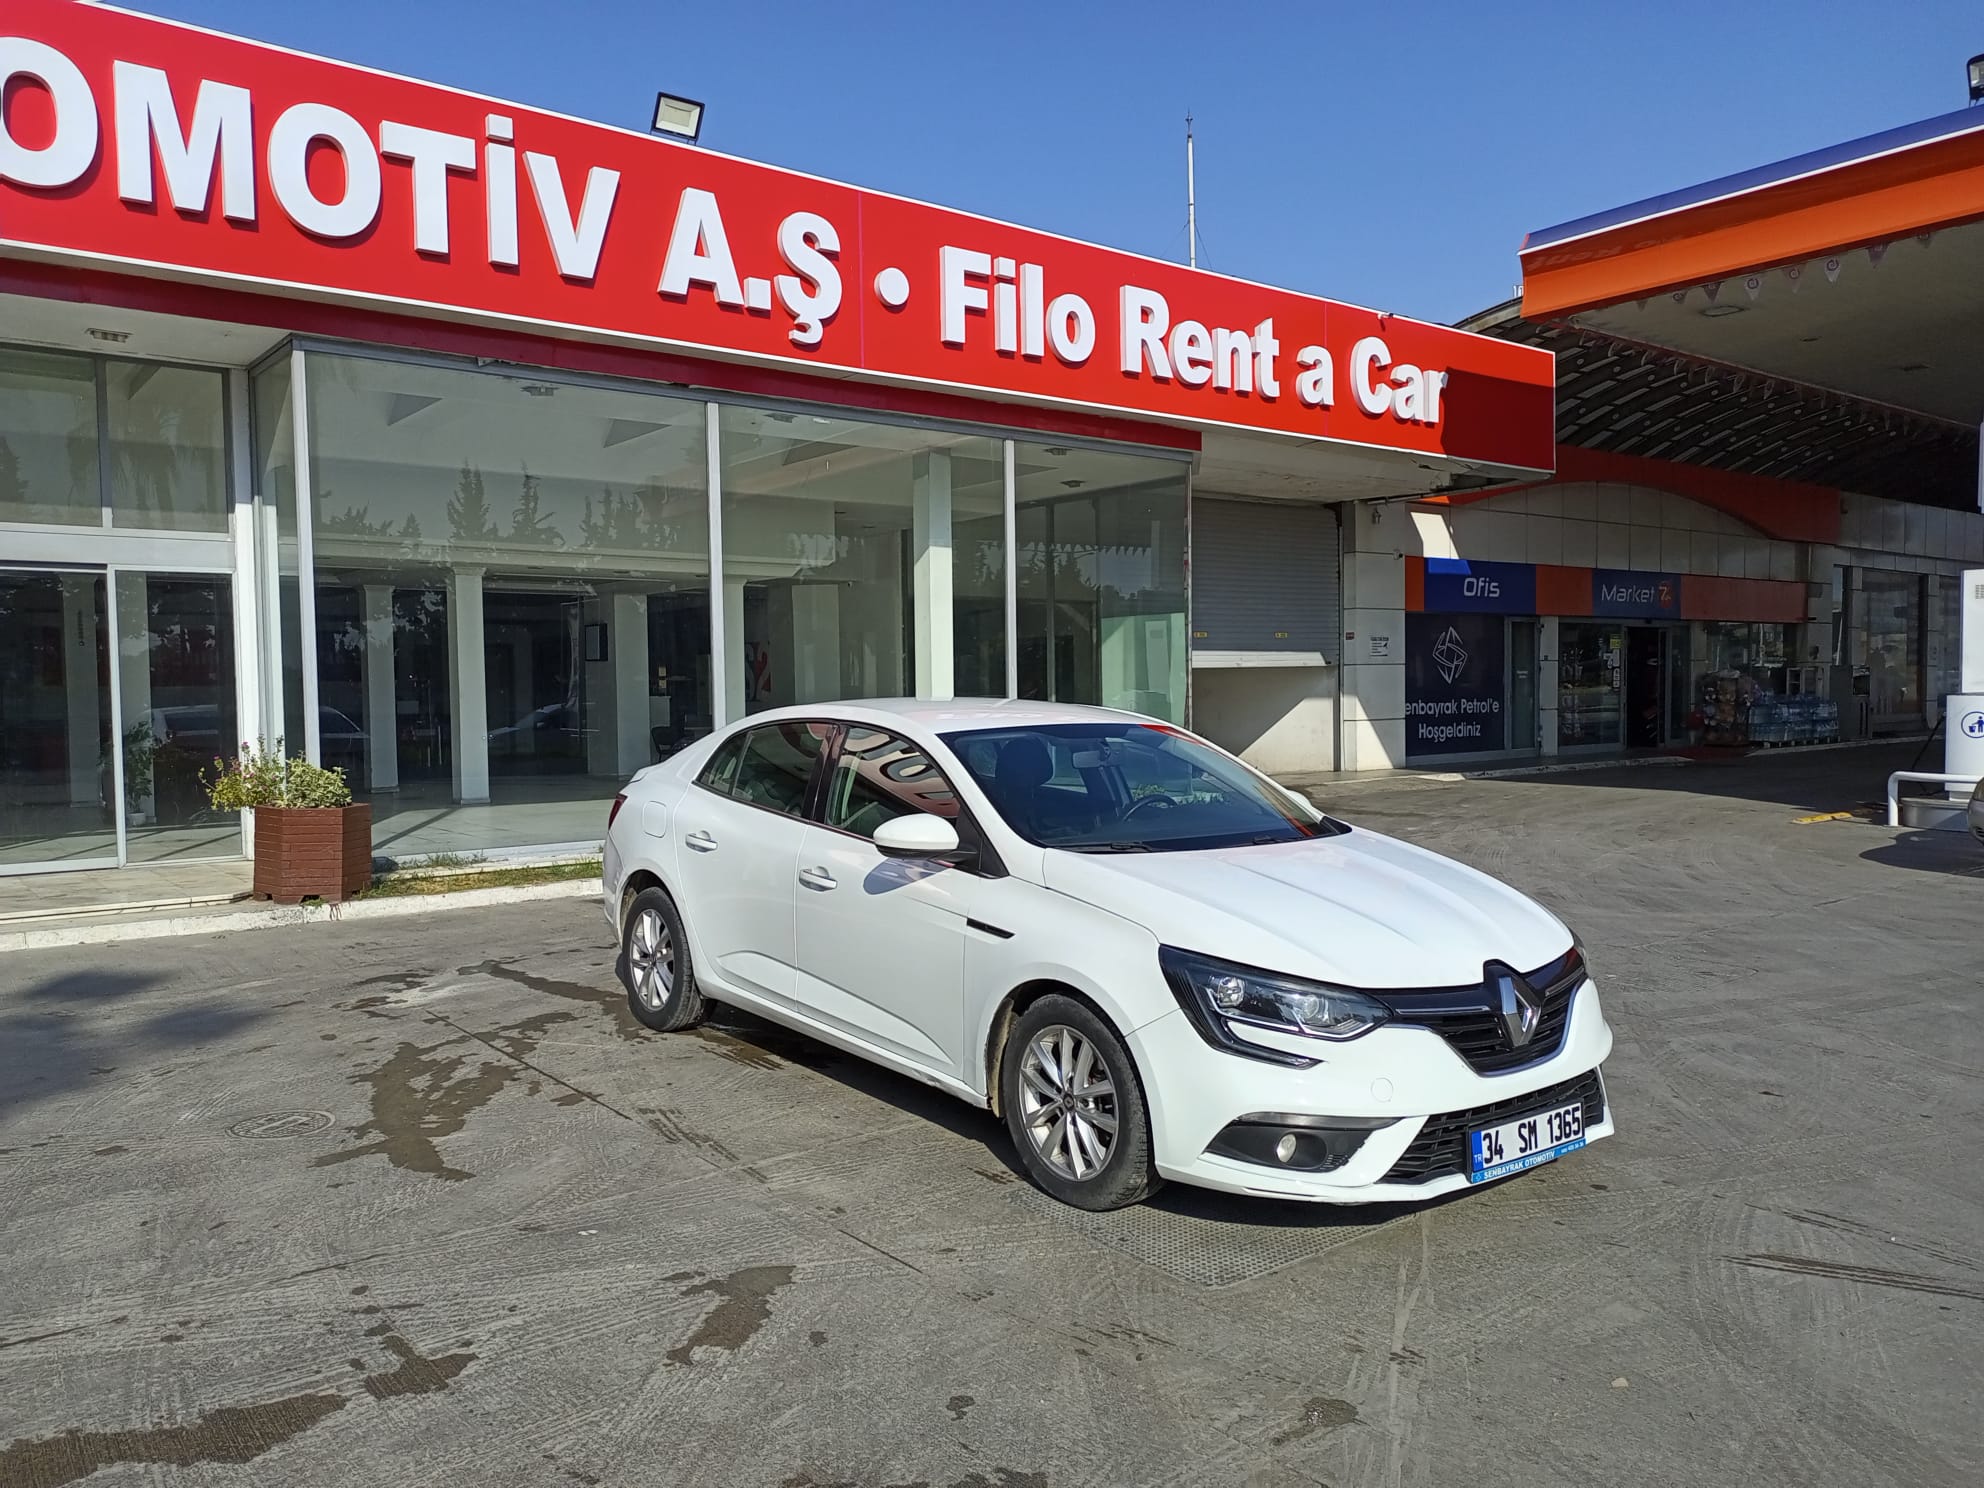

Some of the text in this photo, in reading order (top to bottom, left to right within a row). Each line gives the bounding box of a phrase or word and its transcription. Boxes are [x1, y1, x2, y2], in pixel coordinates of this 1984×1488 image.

[657, 186, 843, 345] A.Ş
[938, 245, 1096, 363] Filo
[1120, 284, 1280, 399] Rent
[1296, 345, 1335, 407] a
[1350, 336, 1448, 425] Car
[1463, 577, 1501, 598] Ofis
[1601, 583, 1655, 603] Market
[1405, 697, 1500, 718] enbayrak Petrol'e
[1418, 721, 1481, 743] Hoşgeldiniz
[1474, 1154, 1483, 1164] TR
[1483, 1130, 1504, 1164] 34
[1518, 1119, 1539, 1154] SM
[1547, 1106, 1581, 1144] 1365
